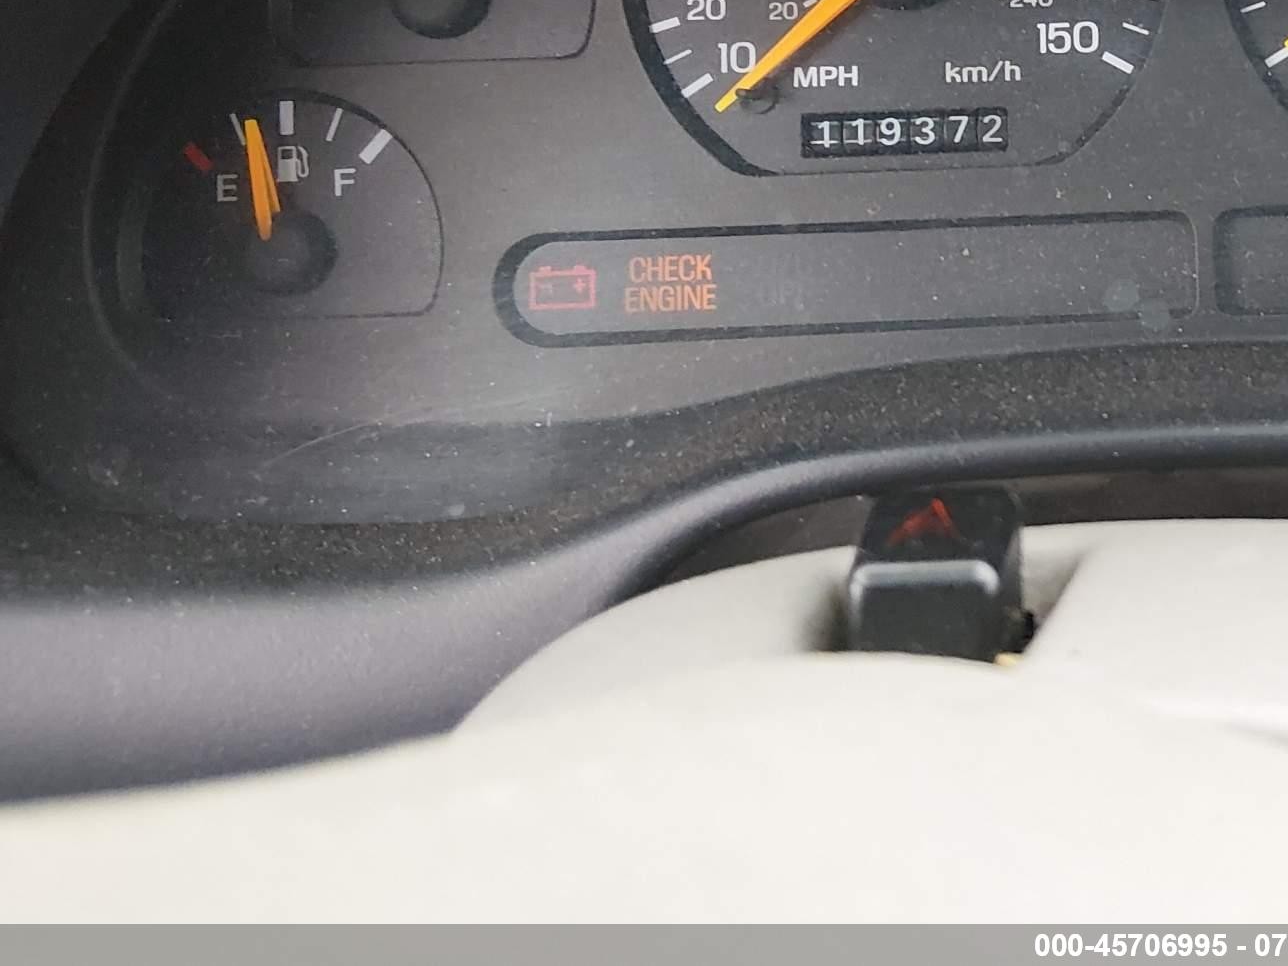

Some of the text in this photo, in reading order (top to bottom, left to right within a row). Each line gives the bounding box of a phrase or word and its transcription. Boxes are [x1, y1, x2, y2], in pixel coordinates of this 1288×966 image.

[769, 2, 798, 20] 20
[1037, 22, 1098, 53] 150
[718, 42, 756, 72] 10
[794, 66, 858, 87] MPH
[946, 61, 1020, 82] km/h
[811, 115, 1003, 148] 119372
[217, 174, 237, 201] E
[335, 169, 356, 196] F
[629, 255, 712, 283] CHECK
[625, 284, 717, 312] ENGINE
